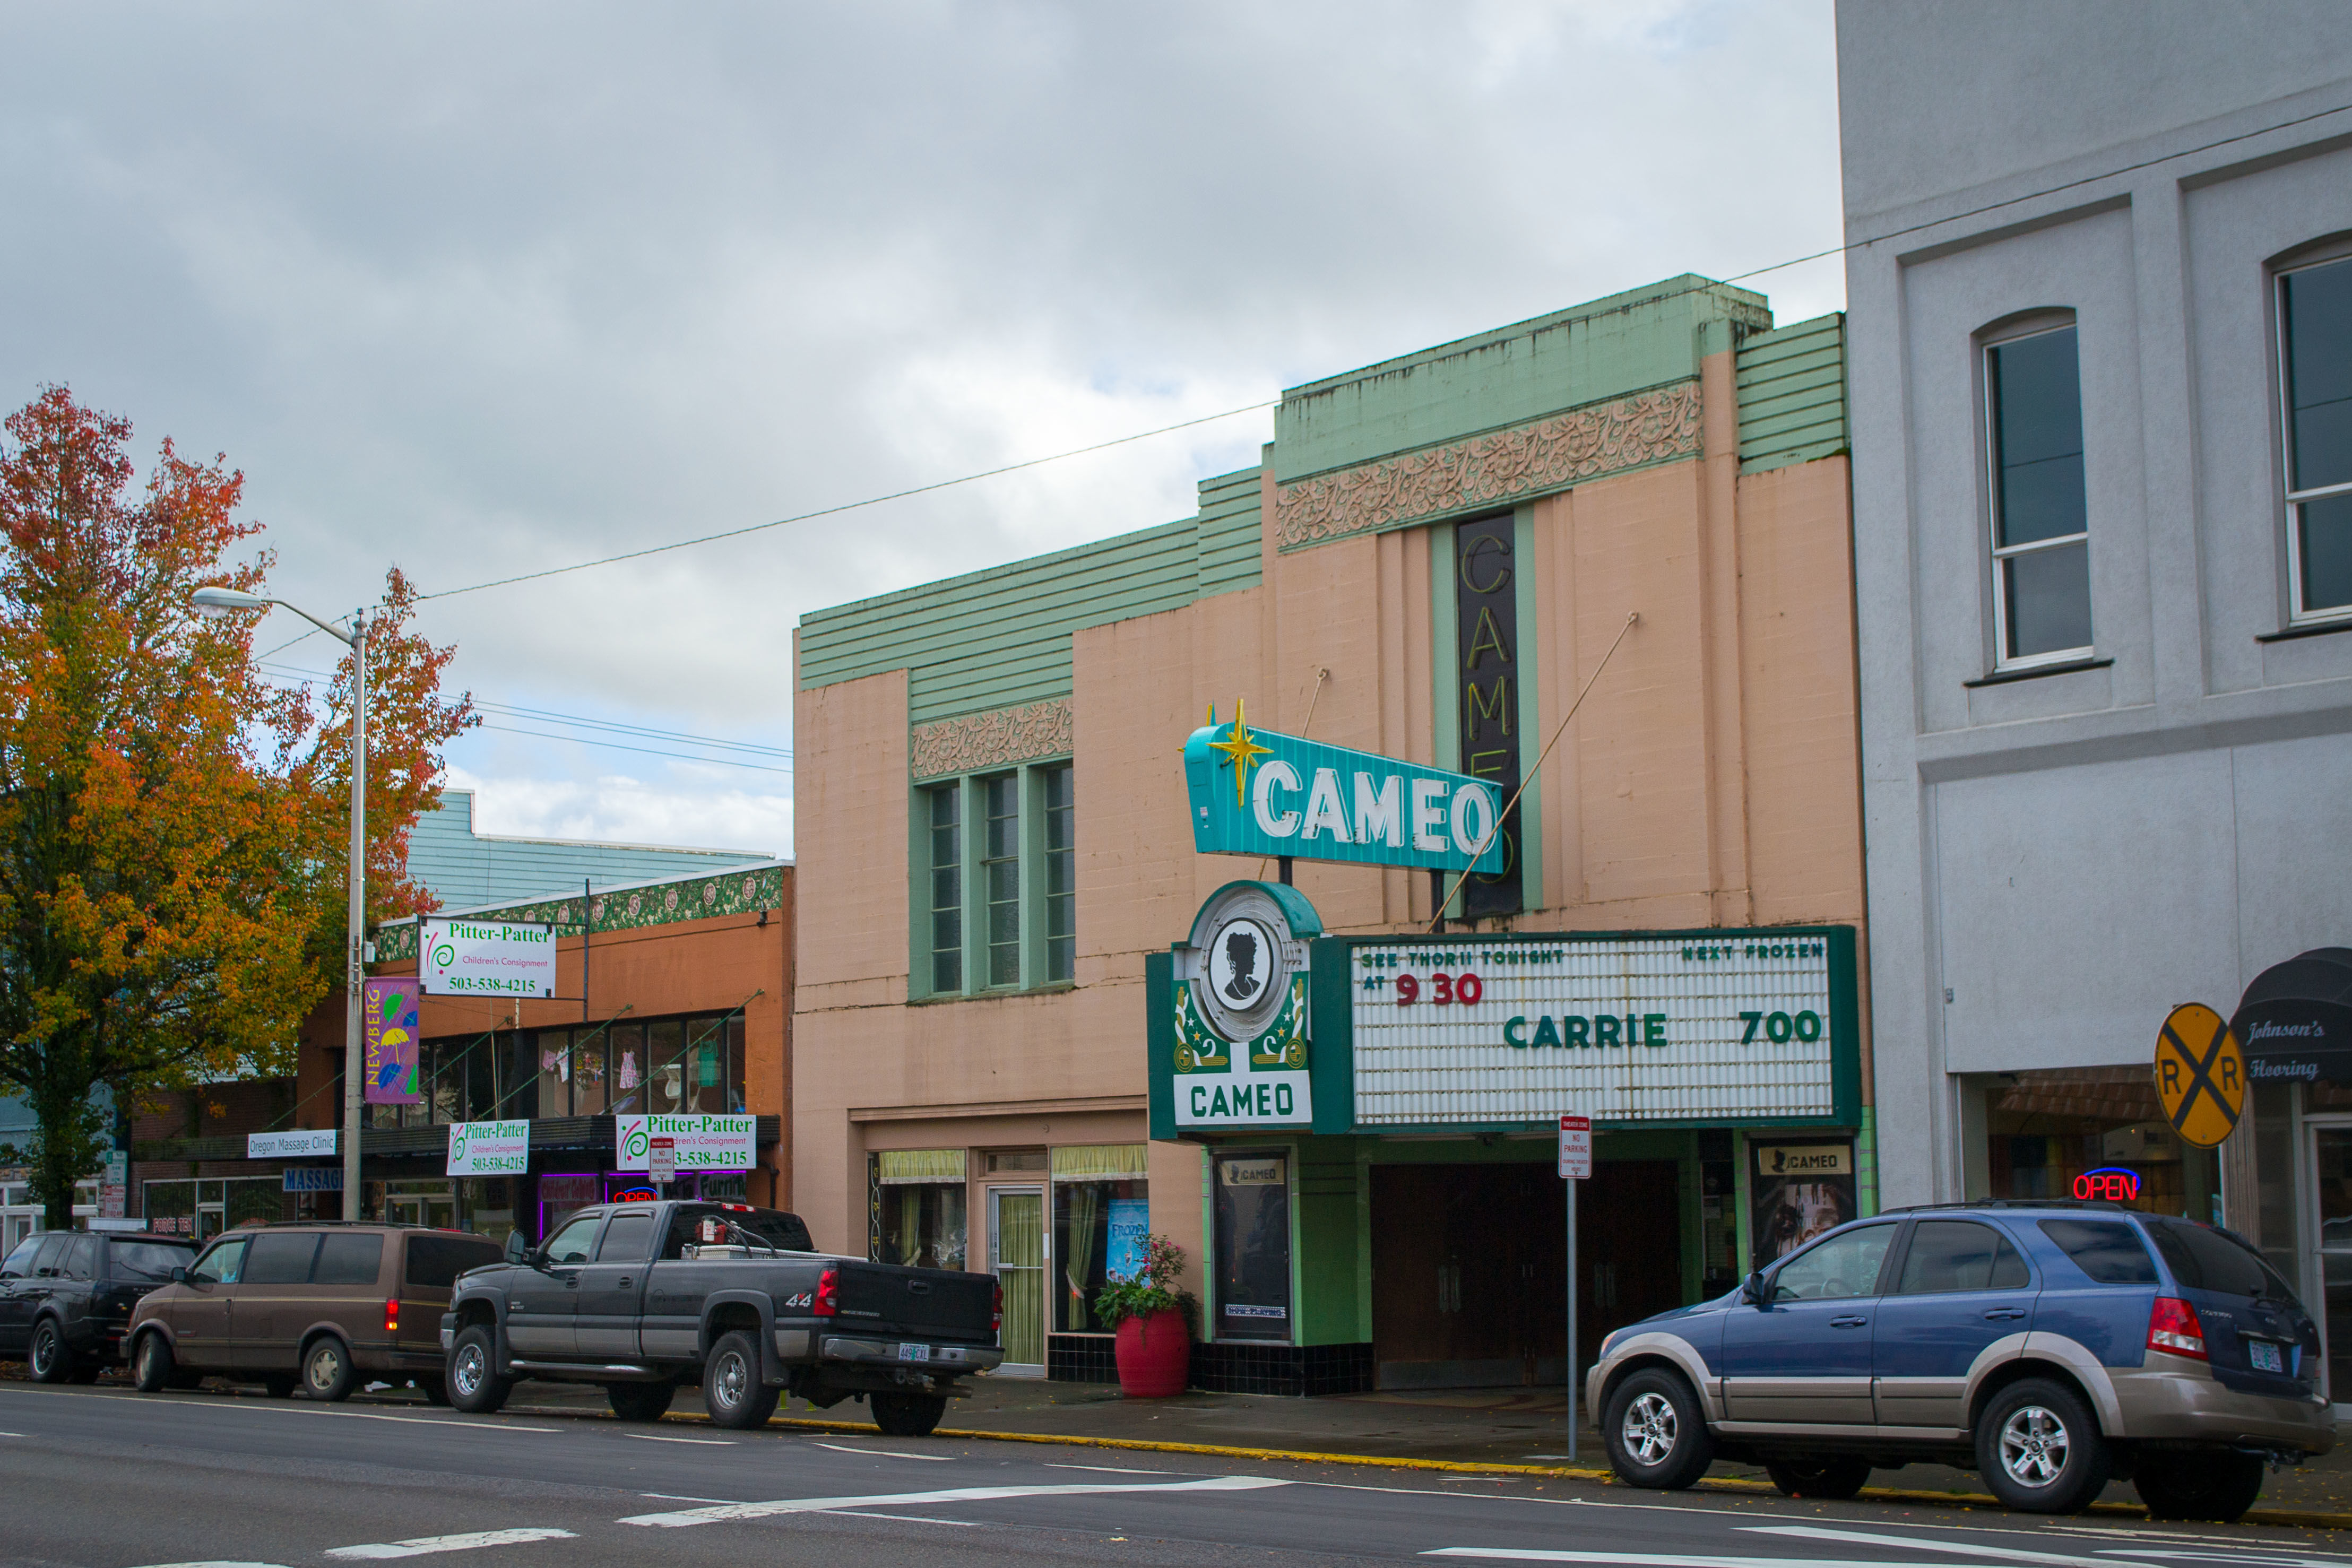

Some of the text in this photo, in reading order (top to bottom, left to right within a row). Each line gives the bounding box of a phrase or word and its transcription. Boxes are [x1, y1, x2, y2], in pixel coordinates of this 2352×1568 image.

[1252, 760, 1498, 856] CAMEO
[449, 923, 551, 943] Pitter-Patter
[1362, 952, 1397, 967] SEE
[1482, 949, 1563, 965] TONIGHT
[1682, 943, 1823, 961] NEXT FROZEN
[463, 956, 548, 968] Children's Consignment
[449, 977, 535, 992] 503-538-4215
[1363, 975, 1385, 990] AT
[1396, 974, 1419, 1006] 9
[367, 989, 380, 1085] NEWBERG
[1503, 1010, 1822, 1049] CARRIE 700
[2246, 1019, 2325, 1046] Johnson's
[2250, 1059, 2320, 1081] Flooring
[1191, 1083, 1293, 1117] CAMEO
[465, 1122, 526, 1140] Pitter-Patter
[647, 1116, 753, 1132] Pitter-Patter
[250, 1136, 334, 1154] Oregon Massage Clinic
[472, 1144, 524, 1154] Children's Consignment
[698, 1136, 747, 1146] Consignment
[472, 1156, 524, 1171] 503-538-4215
[673, 1151, 747, 1165] 3-538-4215
[1788, 1155, 1837, 1168] CAMEO
[1242, 1168, 1276, 1180] CAMEO
[2073, 1175, 2137, 1201] OPEN
[153, 1217, 193, 1233] FORCE TEN
[901, 1348, 927, 1359] 449 CXL
